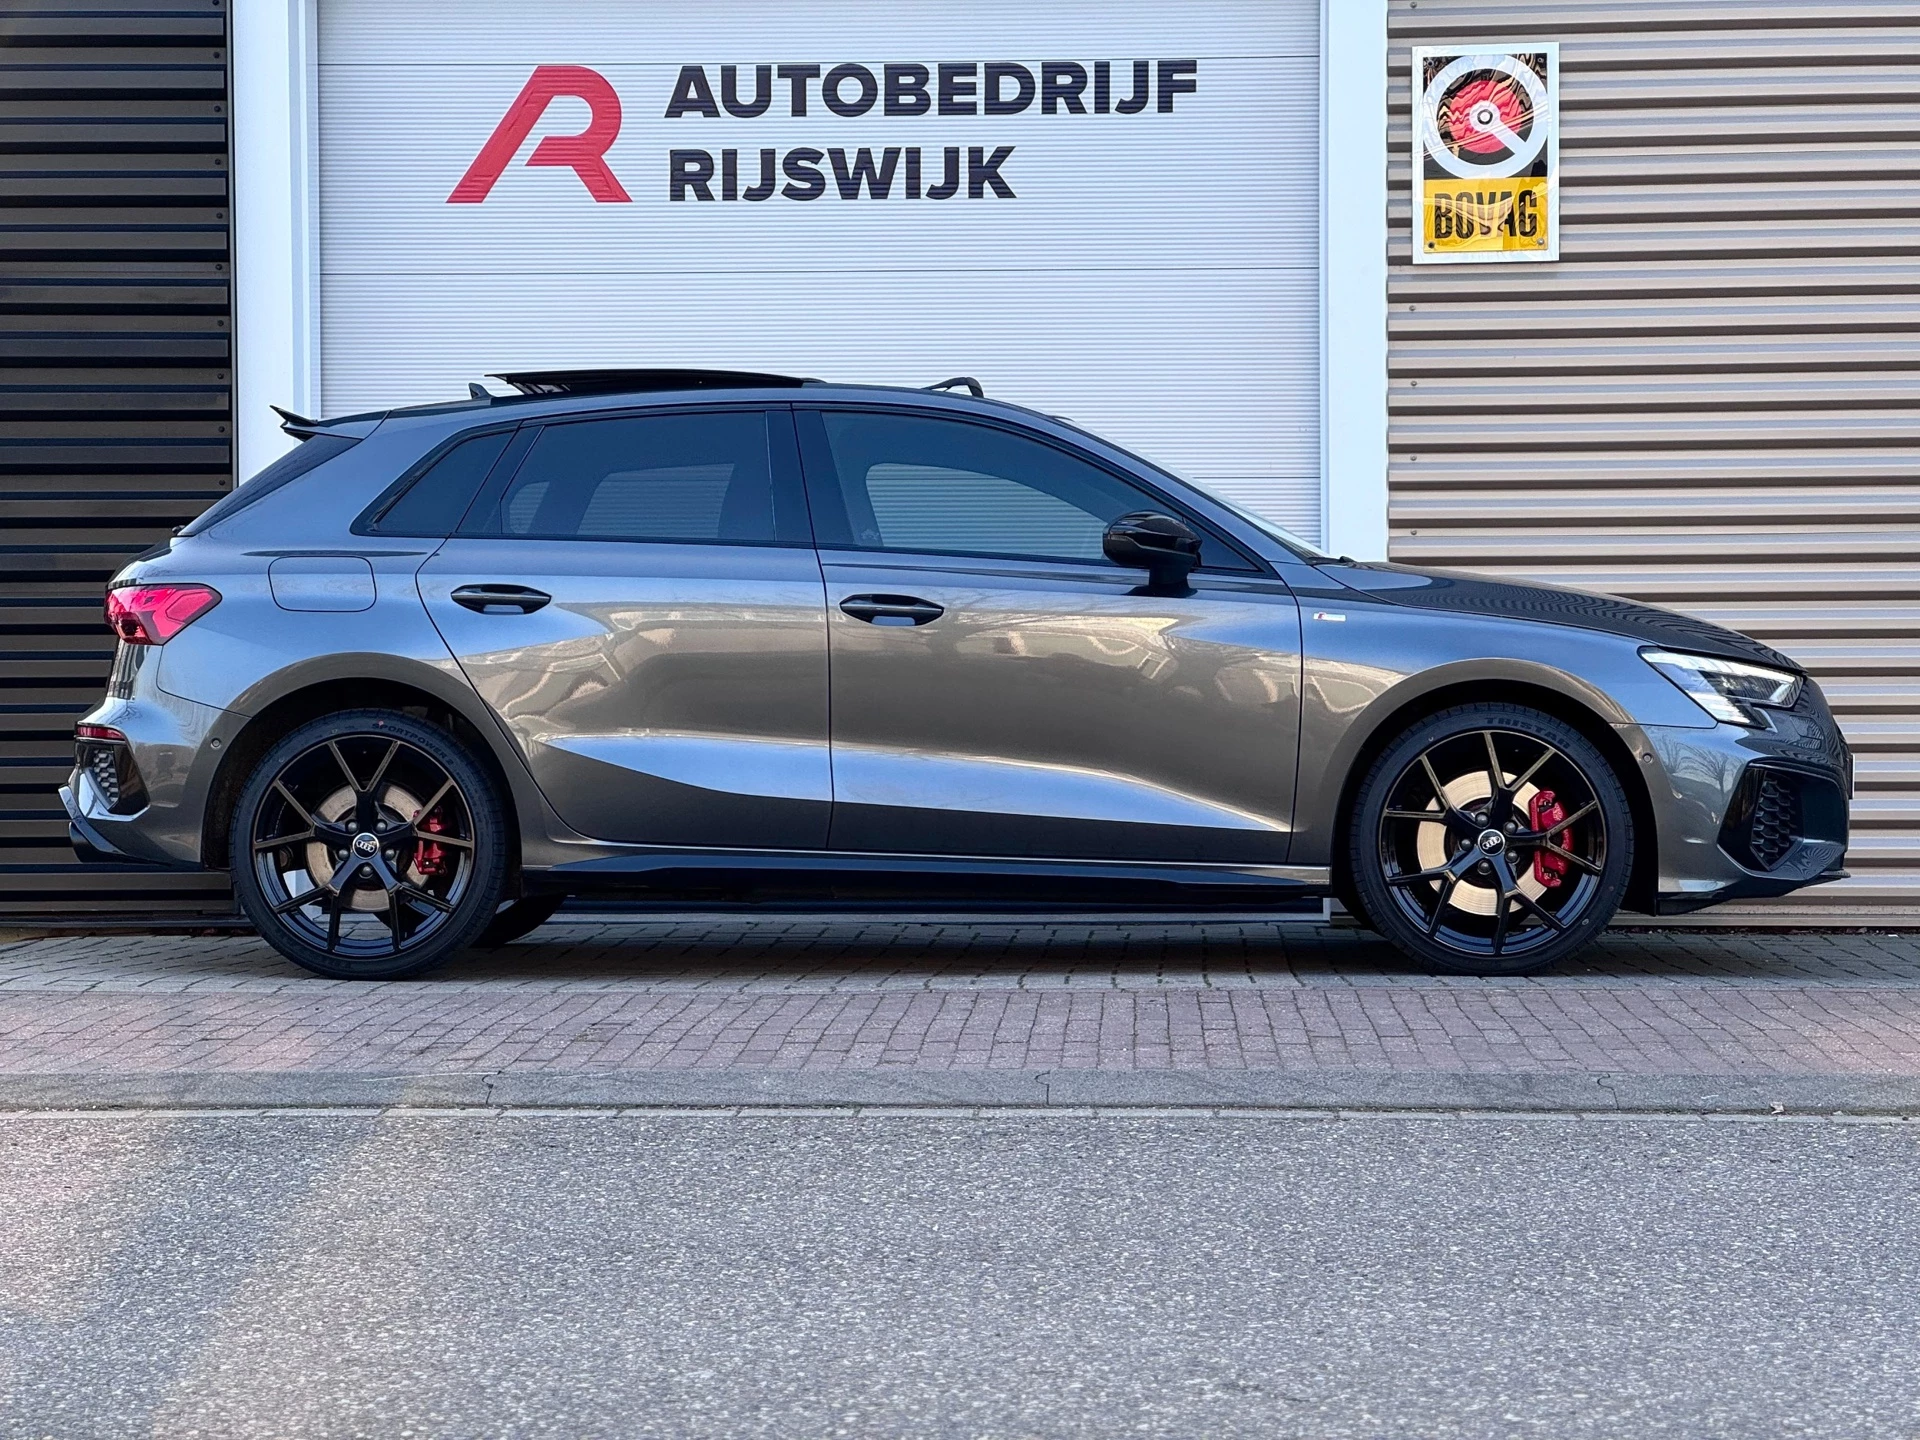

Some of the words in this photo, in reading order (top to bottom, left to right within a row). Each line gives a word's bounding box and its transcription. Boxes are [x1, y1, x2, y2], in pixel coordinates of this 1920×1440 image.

[664, 60, 1198, 118] AUTOBEDRIJF
[669, 145, 1017, 202] RIJSWIJK
[1434, 189, 1538, 239] BOVAG
[371, 722, 447, 759] SPORTPOWER
[1484, 717, 1570, 749] TRISTAR
